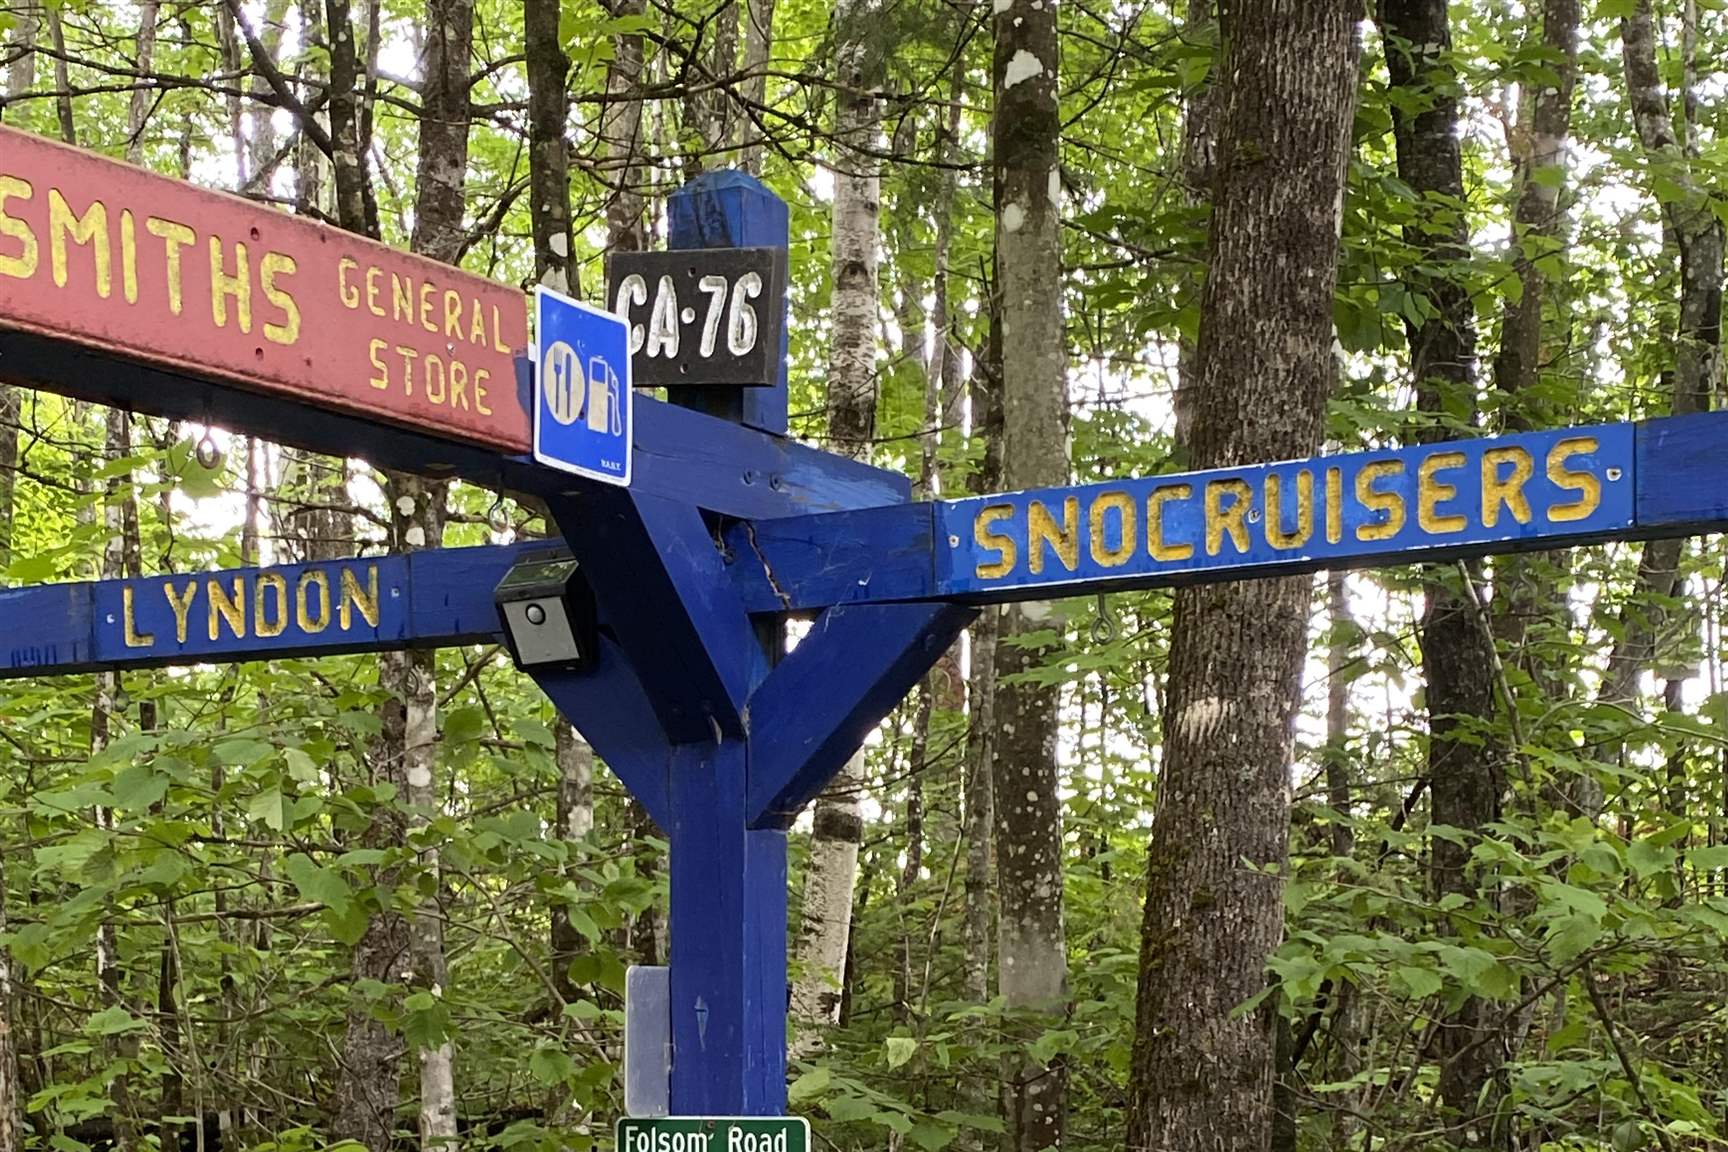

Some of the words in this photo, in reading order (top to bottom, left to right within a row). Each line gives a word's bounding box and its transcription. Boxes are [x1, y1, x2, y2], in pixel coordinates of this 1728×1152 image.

[0, 173, 301, 345] SMITHS
[338, 255, 511, 356] GENERAL
[369, 340, 492, 416] STORE
[974, 436, 1602, 580] SNOCRUISERS
[123, 565, 379, 648] LYNDON
